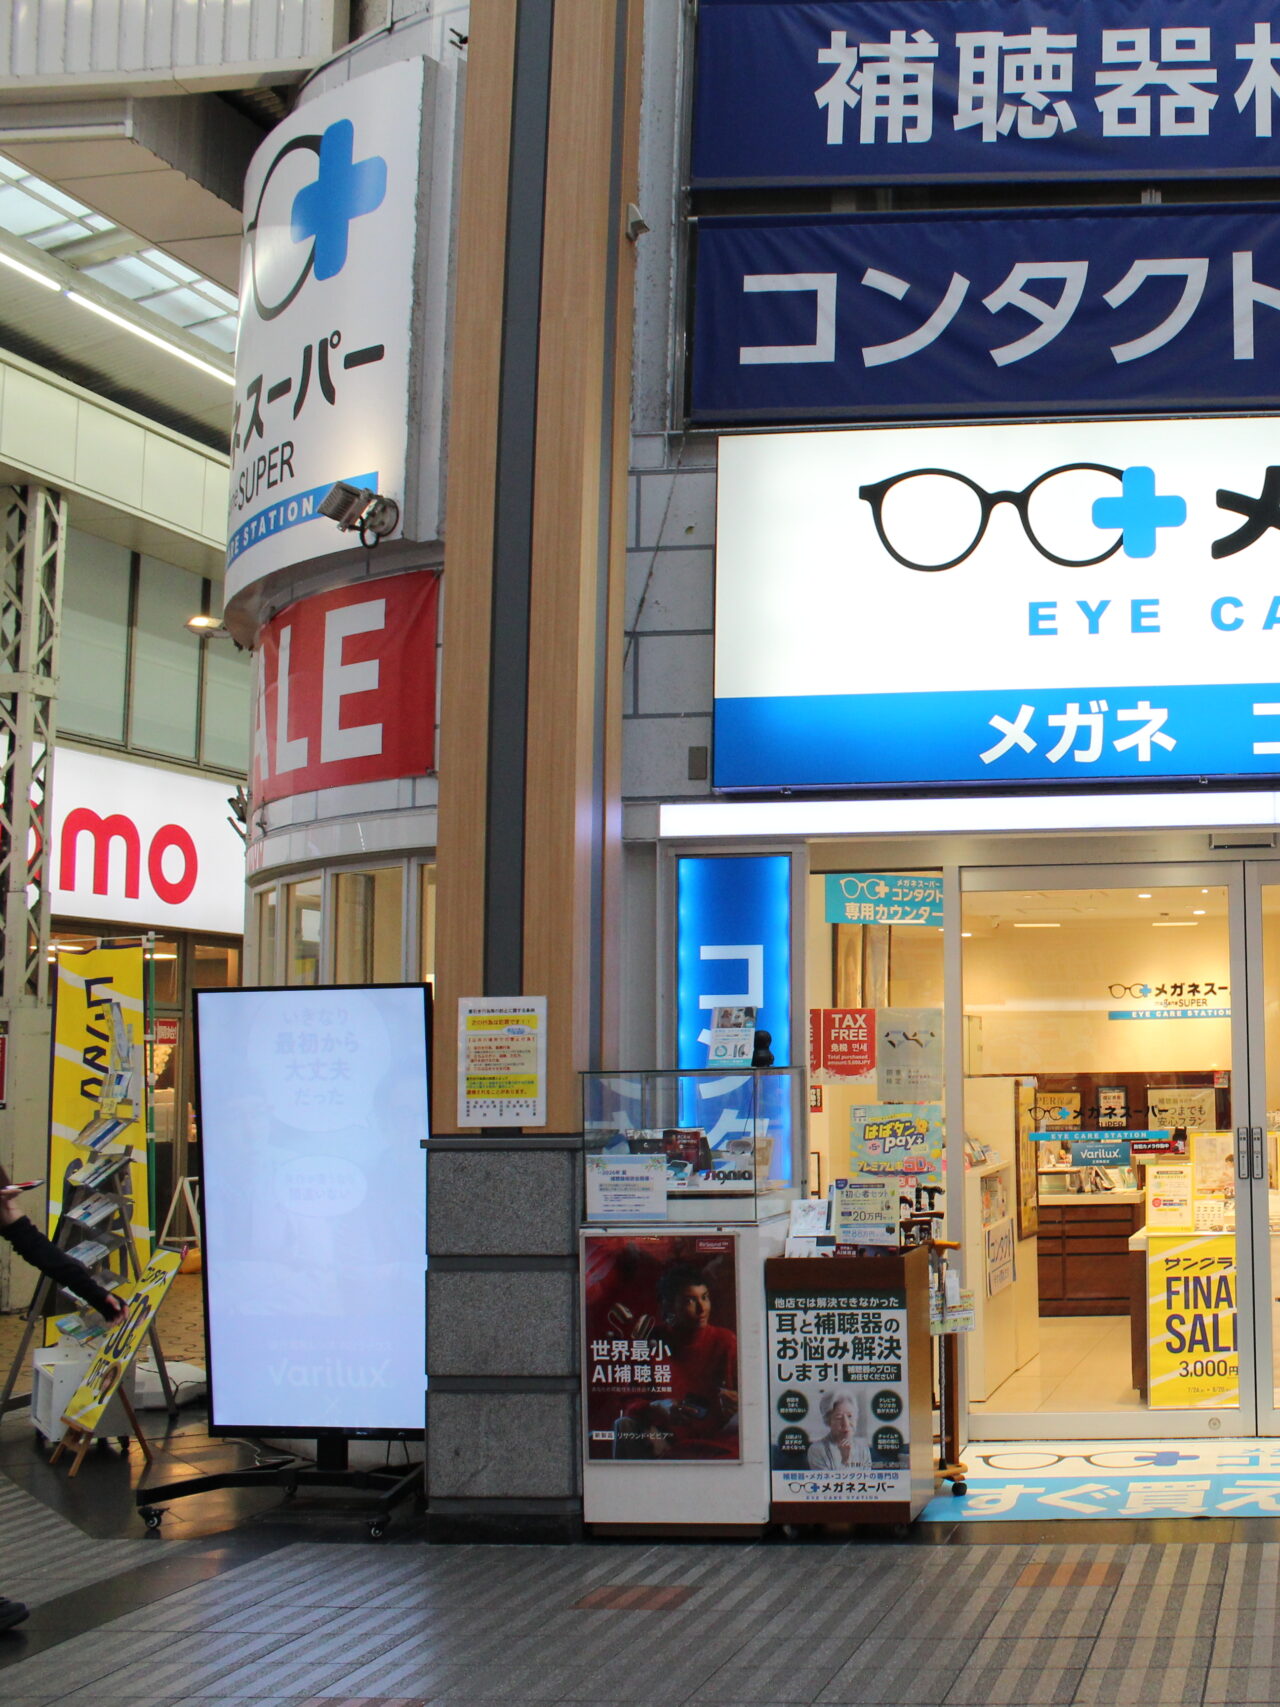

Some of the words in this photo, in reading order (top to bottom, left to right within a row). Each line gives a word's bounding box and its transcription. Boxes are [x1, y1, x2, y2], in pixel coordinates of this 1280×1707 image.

[243, 495, 314, 546] STATION
[1028, 598, 1161, 636] EYE
[979, 700, 1177, 765] メガネ
[896, 879, 941, 889] メガネスーパー
[892, 886, 944, 902] コンタクト
[845, 902, 944, 921] 専用カウンター
[831, 1013, 867, 1028] TAX
[1131, 1010, 1151, 1018] EYE
[1156, 1009, 1182, 1017] CARE
[274, 1032, 360, 1055] 最初から
[830, 1028, 868, 1042] FREE
[284, 1059, 352, 1082] 大丈夫
[1072, 1104, 1169, 1121] メガネスーパー
[1074, 1132, 1100, 1140] CARE
[1104, 1131, 1148, 1139] STATION
[1164, 1257, 1237, 1271] サングラ
[1166, 1275, 1237, 1310] FINA
[774, 1296, 900, 1309] 他店では解決できなかった
[775, 1312, 900, 1335] 耳と補聴器の
[1165, 1313, 1238, 1354] SAL
[590, 1340, 672, 1362] 世界最小
[776, 1336, 902, 1362] お悩み解決
[592, 1364, 672, 1384] AI補聴器
[1178, 1360, 1239, 1378] 3,000円
[821, 1481, 895, 1493] メガネスーパー
